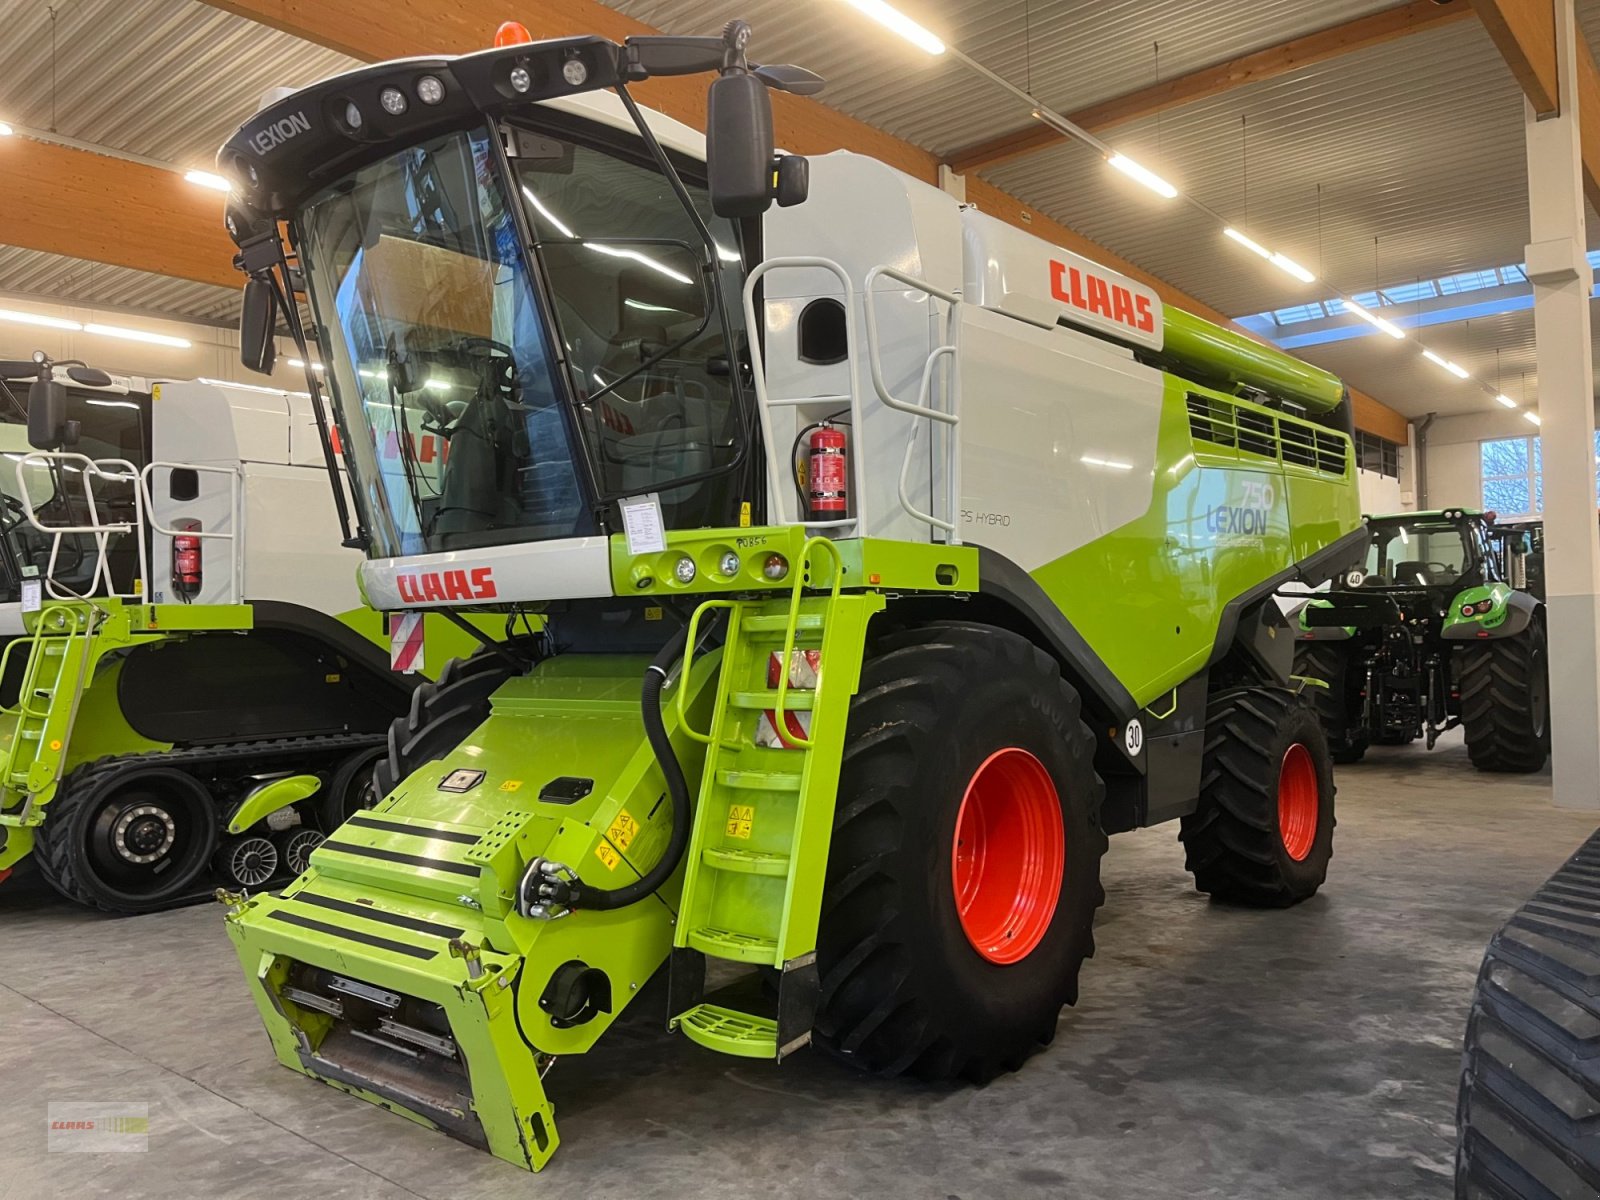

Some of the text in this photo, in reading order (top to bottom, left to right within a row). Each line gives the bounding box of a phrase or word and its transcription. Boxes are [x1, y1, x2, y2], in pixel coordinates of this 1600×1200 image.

[248, 111, 312, 156] LEXION
[1049, 259, 1154, 334] CLAAS
[1241, 480, 1274, 512] 750
[975, 512, 1011, 527] HYBRID
[1206, 504, 1267, 536] LEXION
[396, 567, 497, 604] CLAAS
[1350, 573, 1361, 584] 40
[1128, 724, 1140, 749] 30
